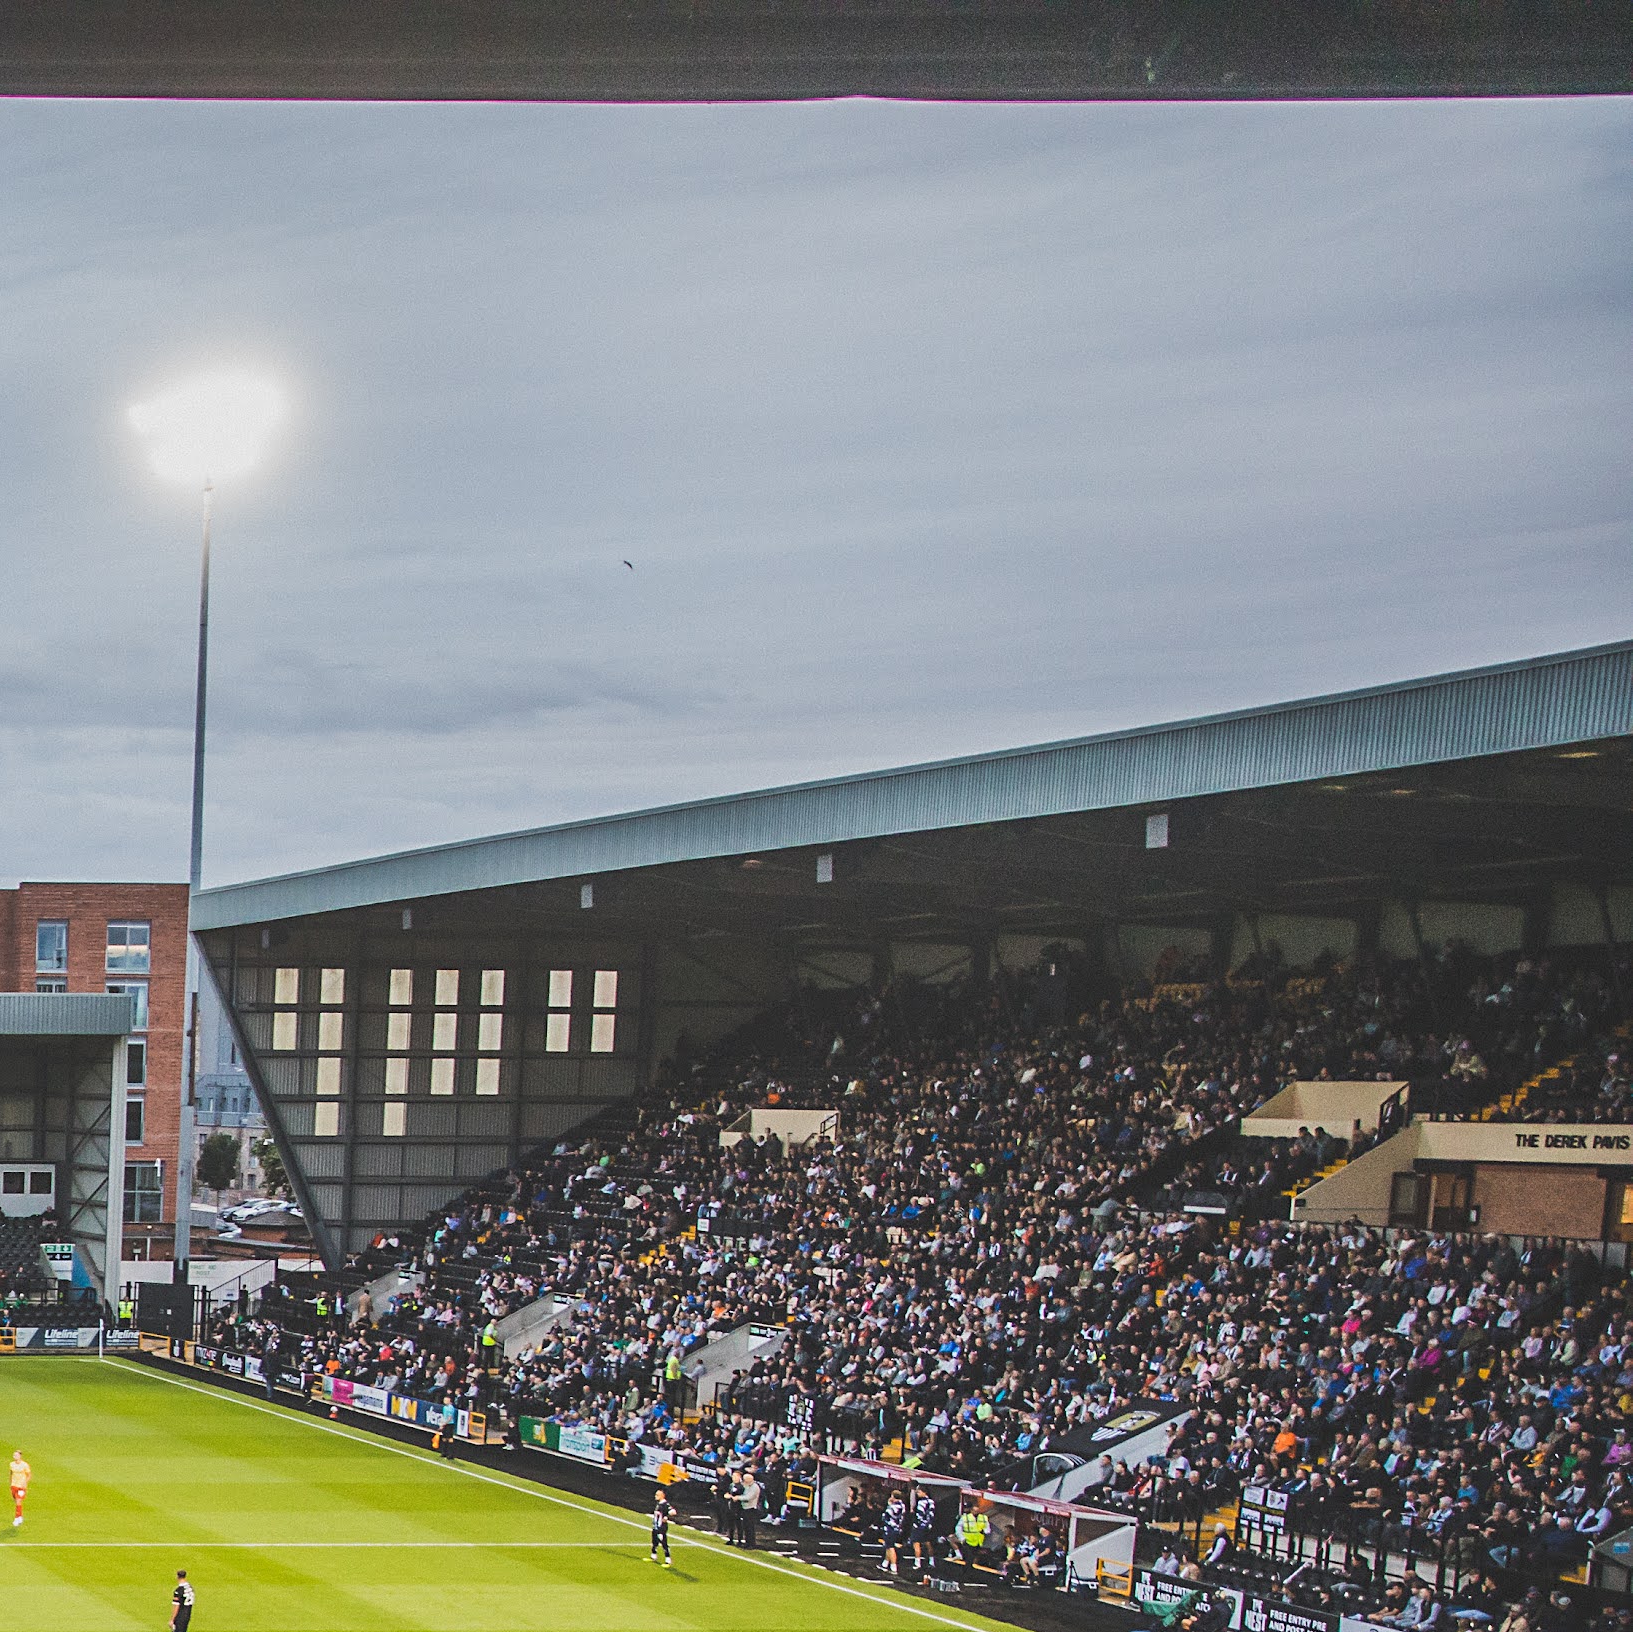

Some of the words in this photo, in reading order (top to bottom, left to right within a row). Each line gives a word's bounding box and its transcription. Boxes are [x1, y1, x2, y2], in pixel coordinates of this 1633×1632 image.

[1515, 1134, 1540, 1148] THE
[1545, 1134, 1587, 1149] DEREK
[1593, 1135, 1631, 1150] PAVIS
[45, 1328, 78, 1340] Lifeline
[105, 1329, 139, 1340] Lifeline
[1135, 1582, 1155, 1602] NEST
[1157, 1581, 1173, 1594] FREE
[1156, 1592, 1171, 1602] AND
[1245, 1609, 1268, 1632] NEST
[1269, 1610, 1287, 1622] FREE
[1287, 1612, 1311, 1628] ENTRY
[1311, 1618, 1327, 1632] PRE
[1269, 1620, 1285, 1632] AND
